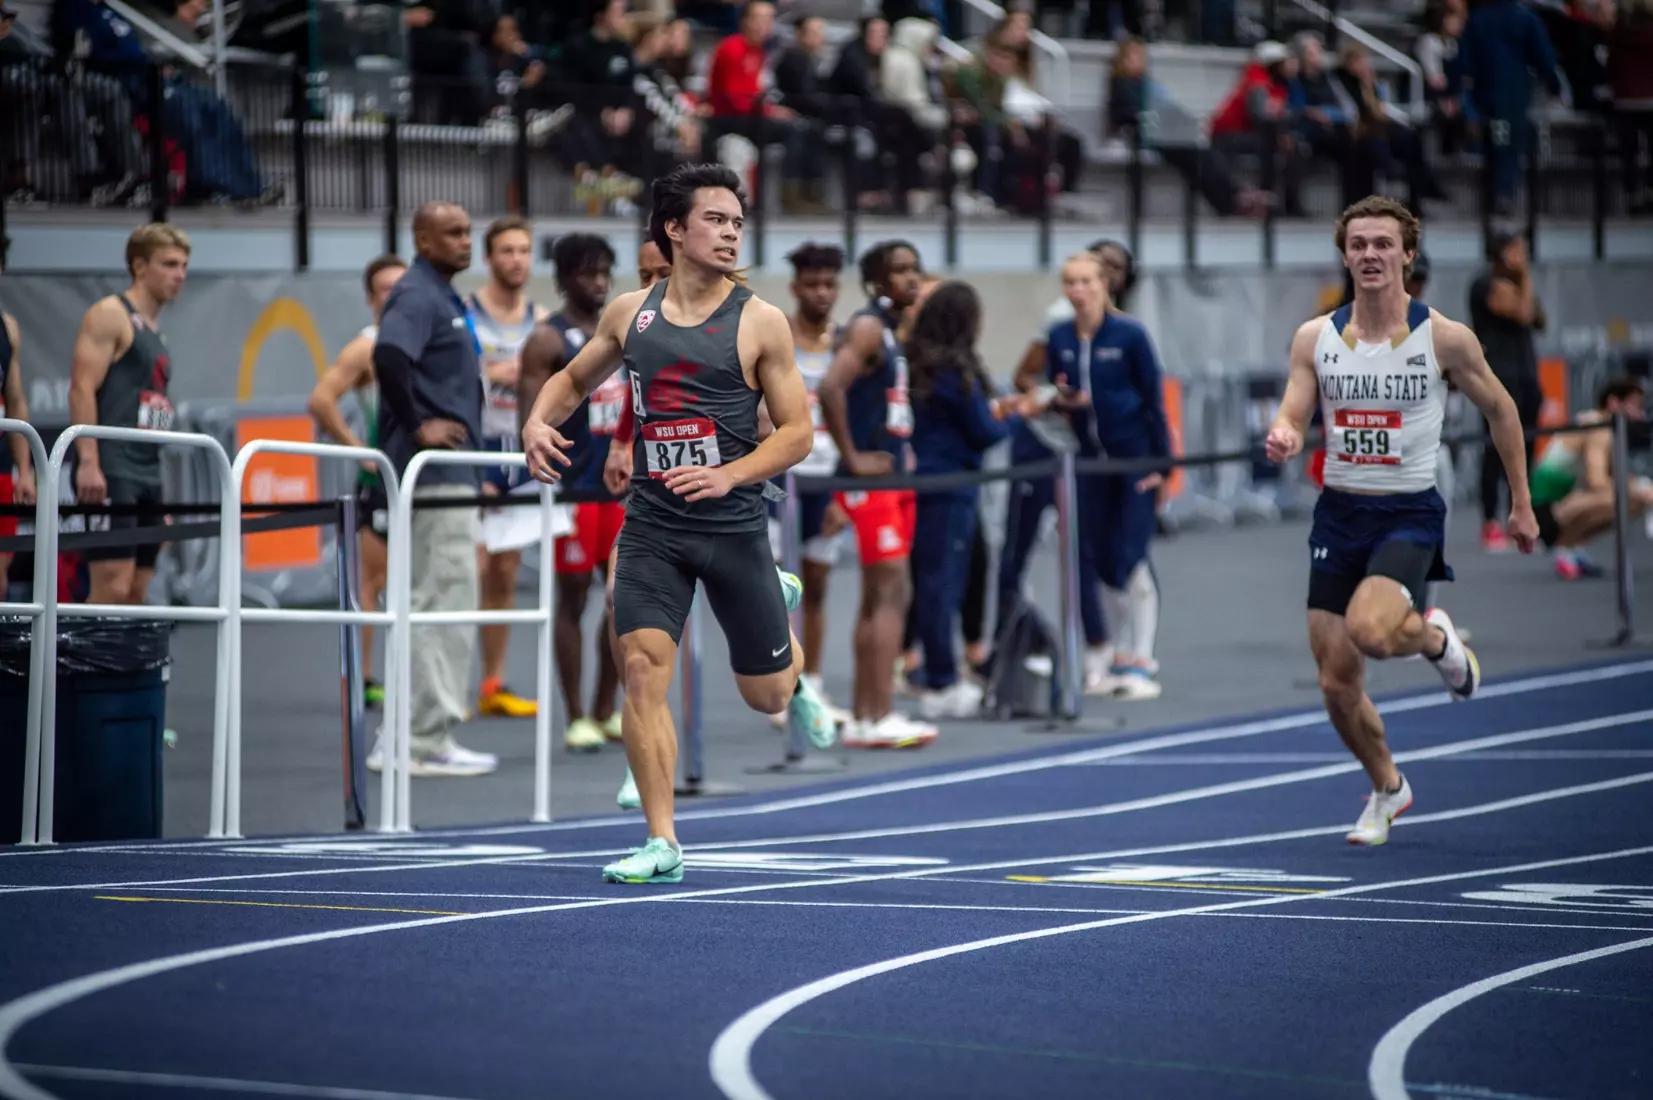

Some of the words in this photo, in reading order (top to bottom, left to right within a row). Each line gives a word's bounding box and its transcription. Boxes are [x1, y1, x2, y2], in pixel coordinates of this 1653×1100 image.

[1320, 374, 1378, 401] MONTANA
[1384, 374, 1428, 402] STATE
[655, 425, 675, 437] WSU
[677, 424, 699, 436] OPEN
[1347, 414, 1365, 426] WSU
[1366, 414, 1388, 426] OPEN
[655, 439, 708, 471] 875
[1343, 429, 1390, 455] 559
